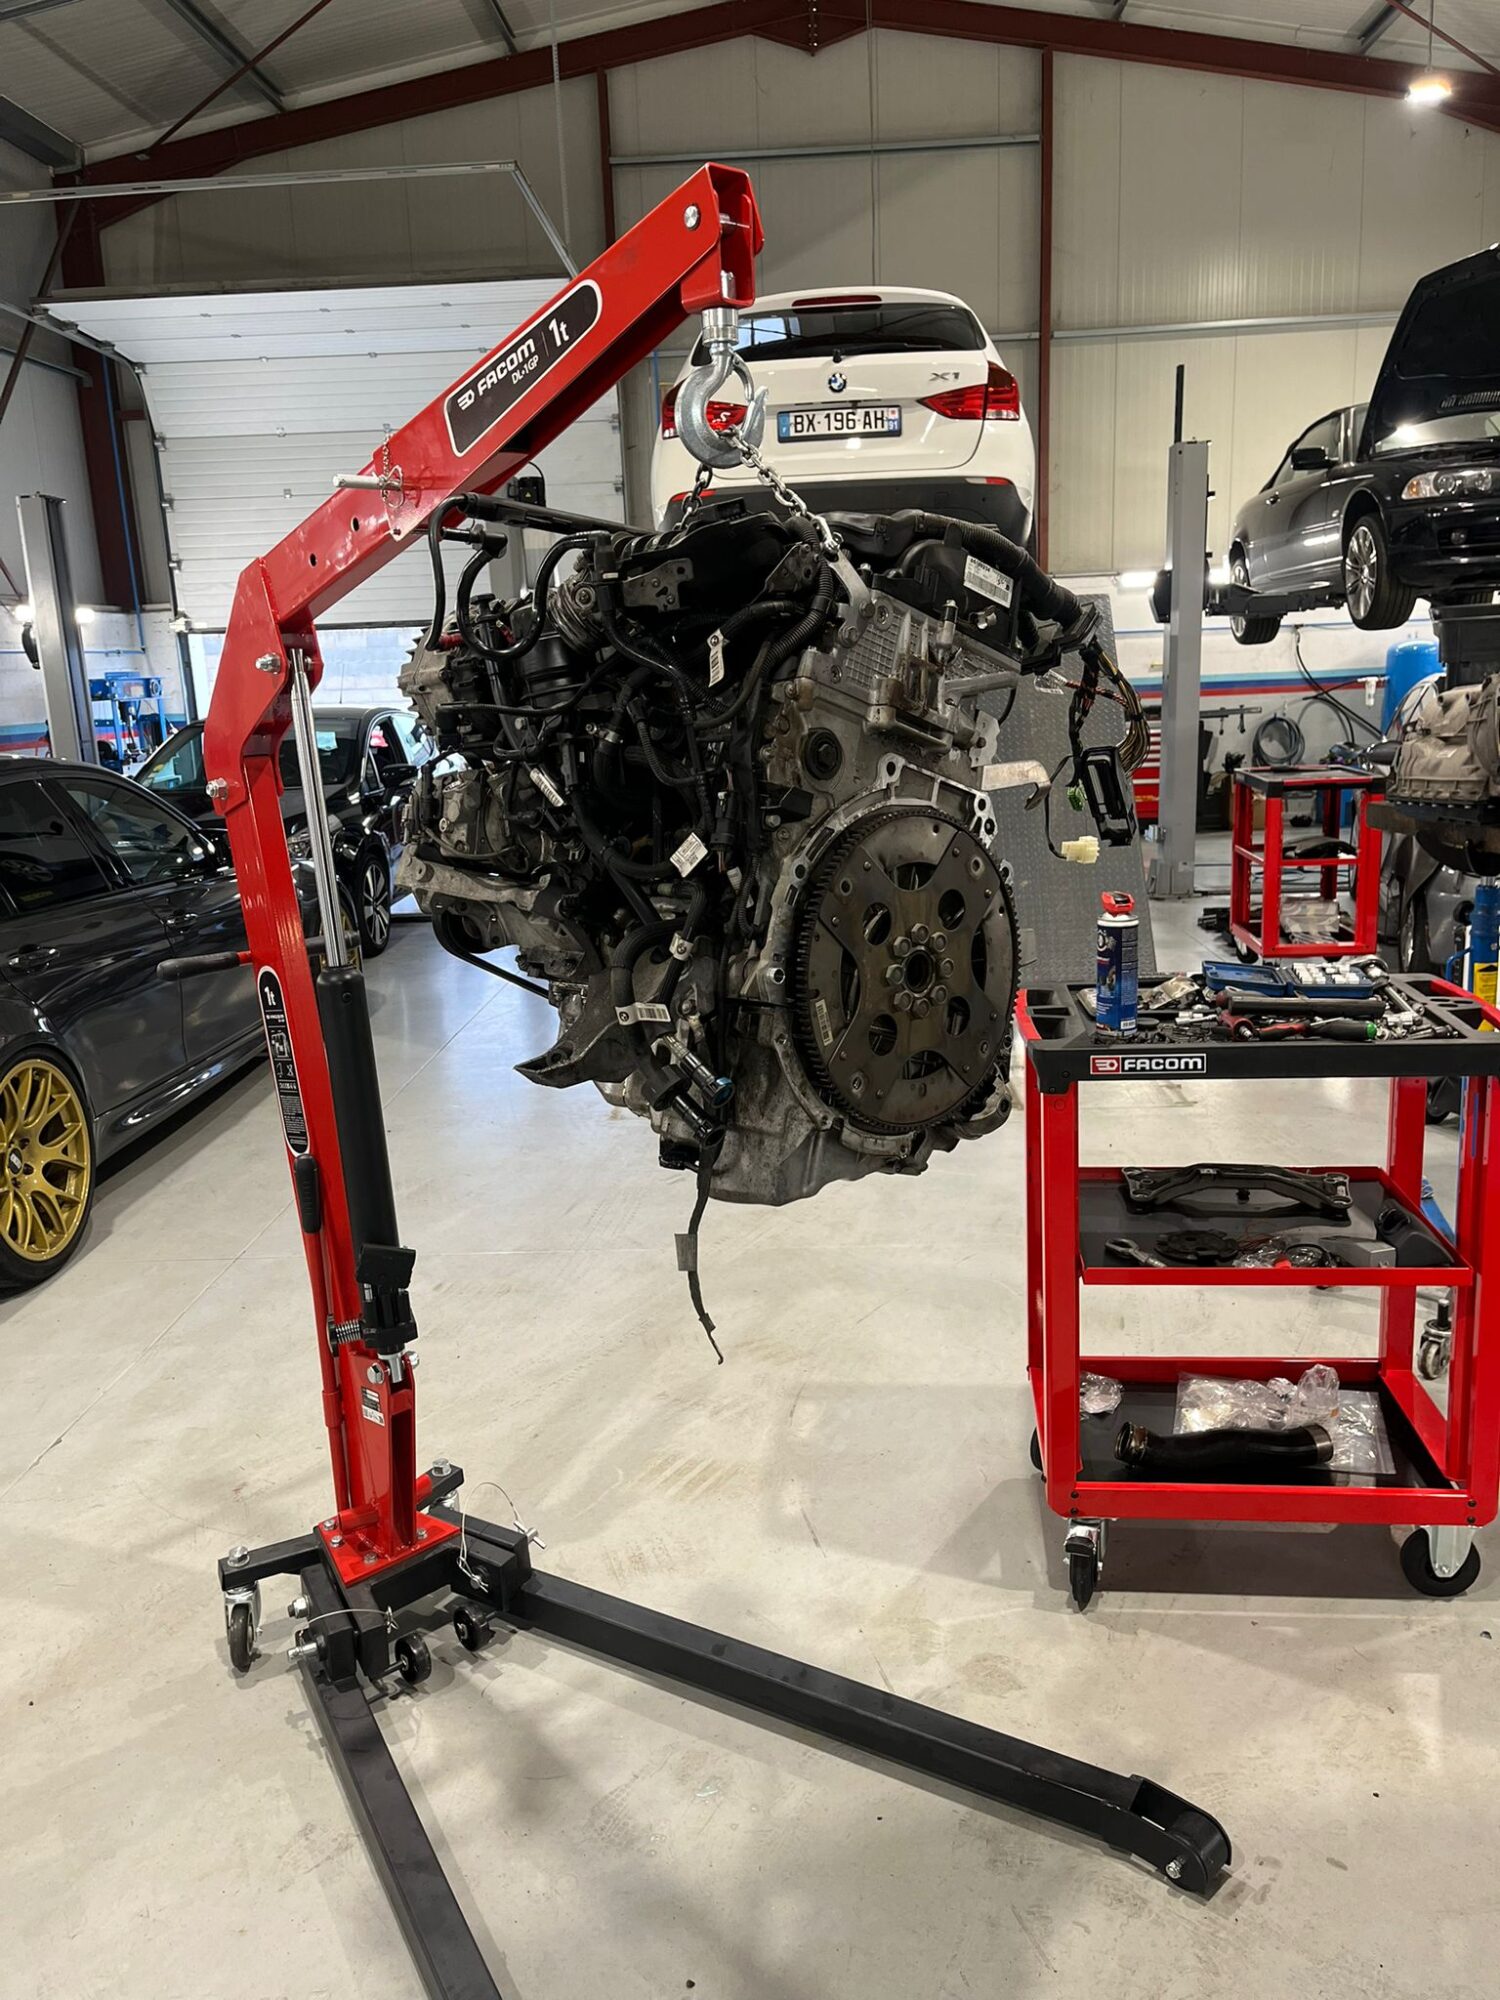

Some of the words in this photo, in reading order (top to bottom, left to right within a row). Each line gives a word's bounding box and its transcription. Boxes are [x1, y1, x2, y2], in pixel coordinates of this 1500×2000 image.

[477, 338, 536, 397] FACOM
[548, 317, 570, 348] 1t
[929, 371, 961, 382] X1
[264, 986, 276, 1006] 1t
[1124, 1058, 1202, 1071] FACOM
